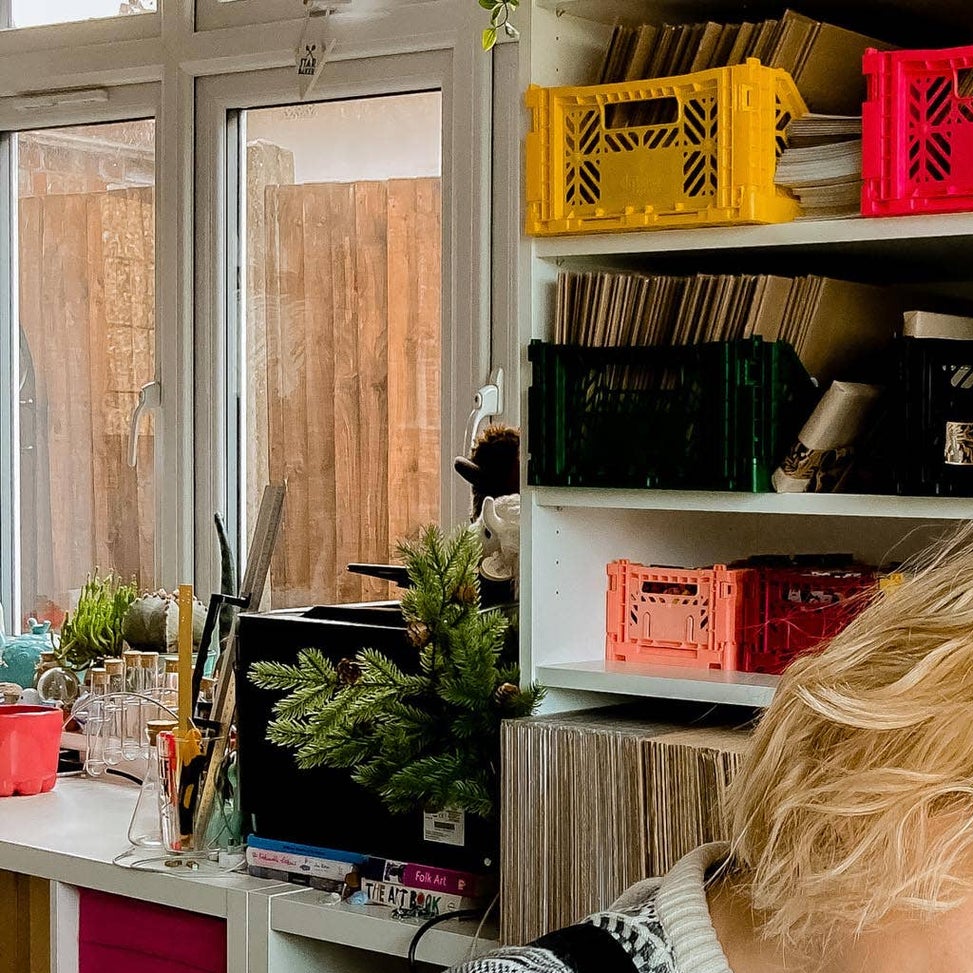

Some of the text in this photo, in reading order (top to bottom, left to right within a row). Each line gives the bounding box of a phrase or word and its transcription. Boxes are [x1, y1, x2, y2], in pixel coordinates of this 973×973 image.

[415, 871, 447, 887] Folk Art
[365, 882, 386, 903] THE
[410, 890, 442, 915] BOOK
